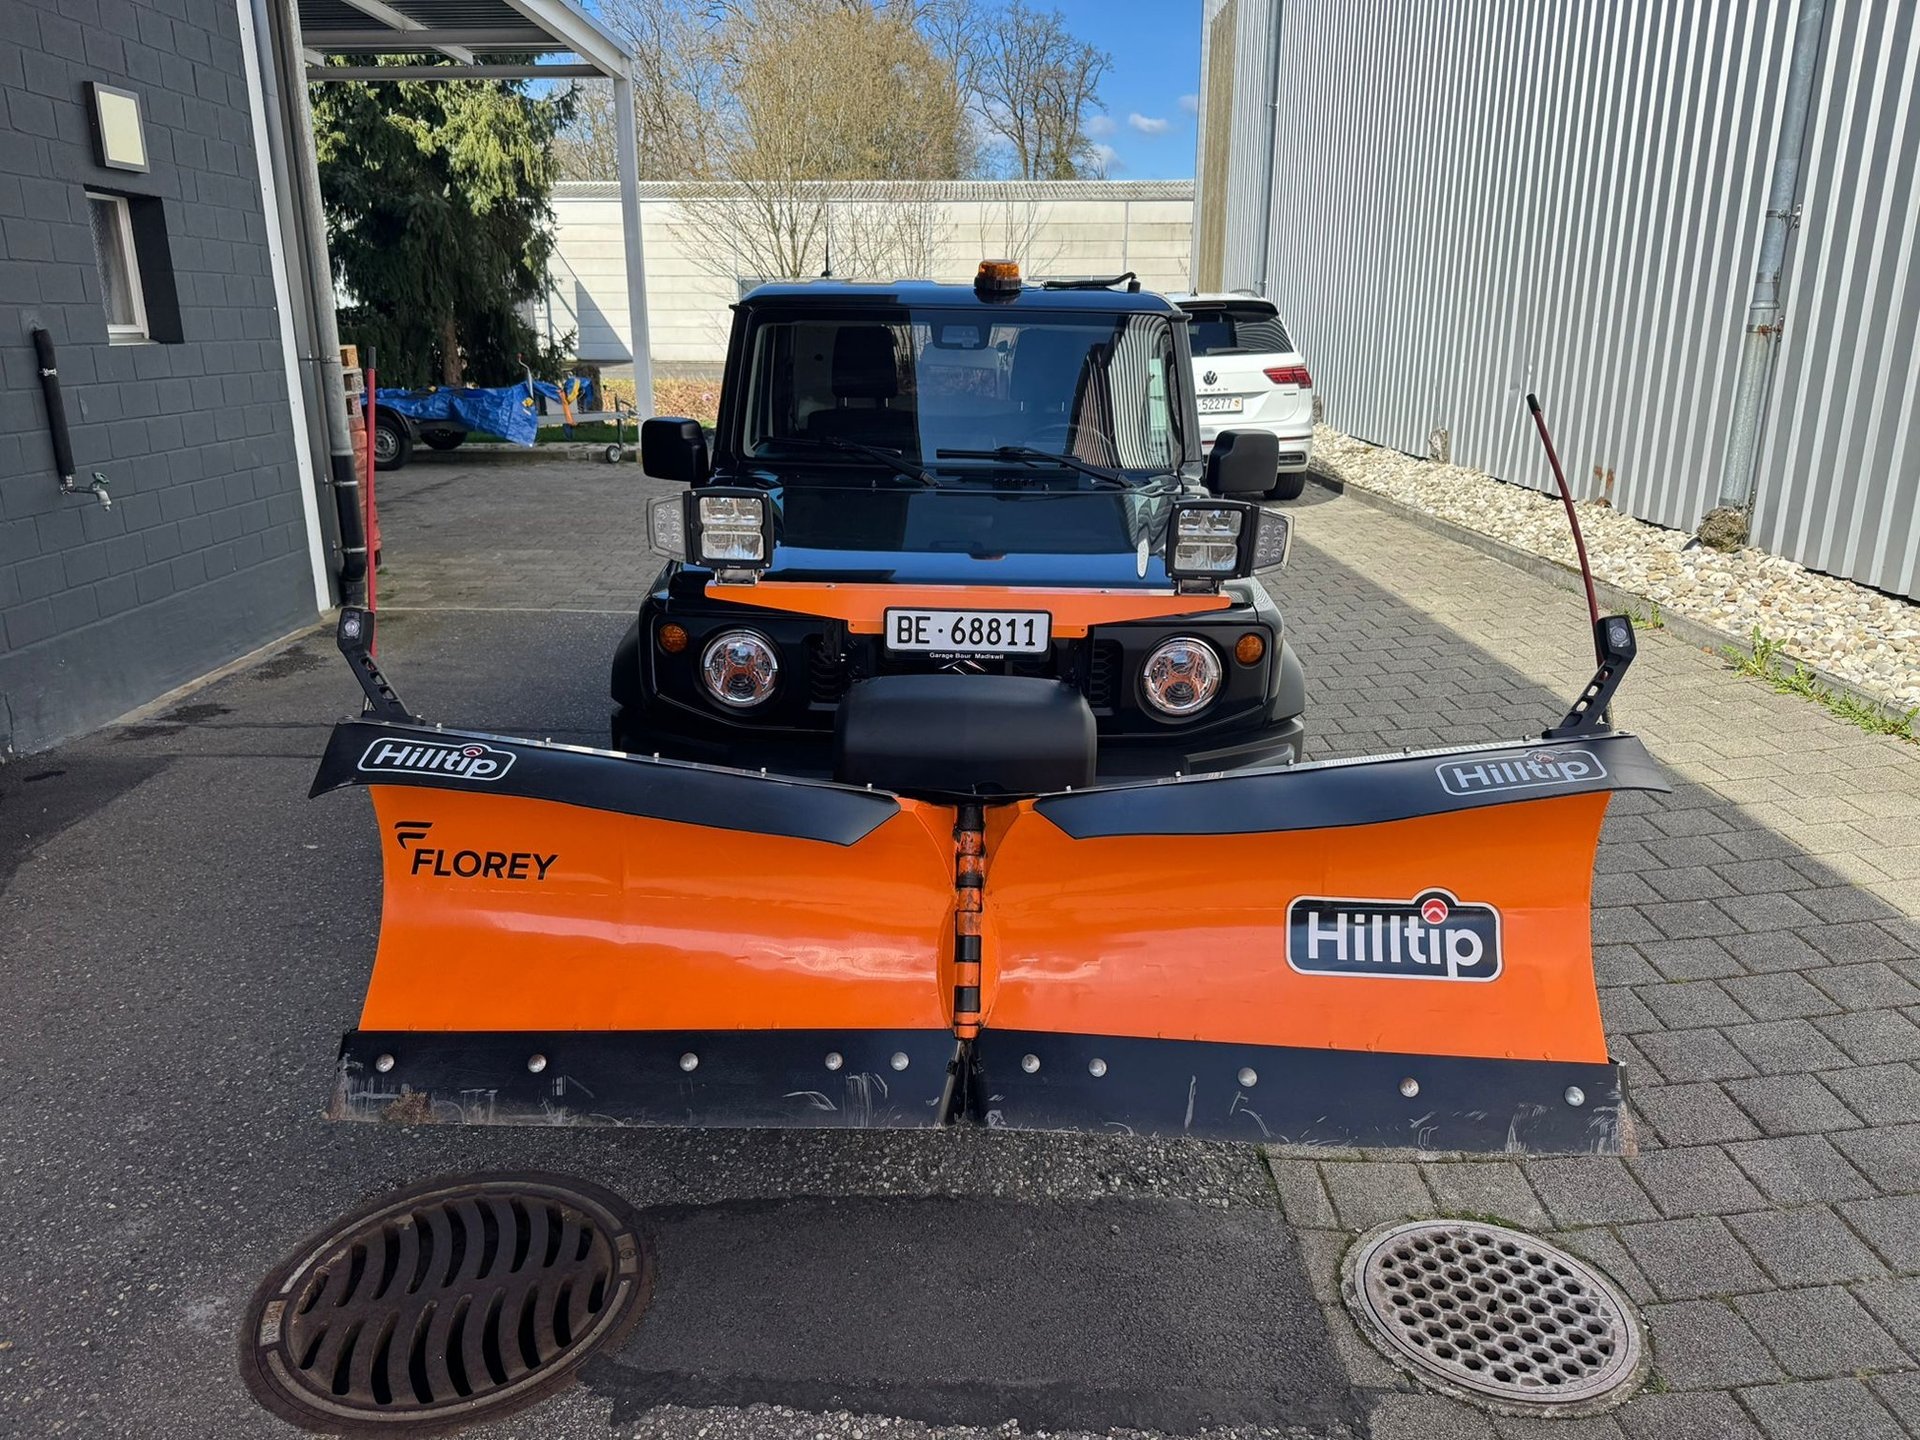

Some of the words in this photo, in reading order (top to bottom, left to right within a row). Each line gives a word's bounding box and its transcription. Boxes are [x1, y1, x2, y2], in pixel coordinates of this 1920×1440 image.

[929, 652, 953, 661] Garage
[373, 743, 498, 777] Hilltip
[1452, 756, 1590, 788] Hilltip
[411, 848, 559, 880] FLOREY
[1308, 900, 1484, 978] Hilltip
